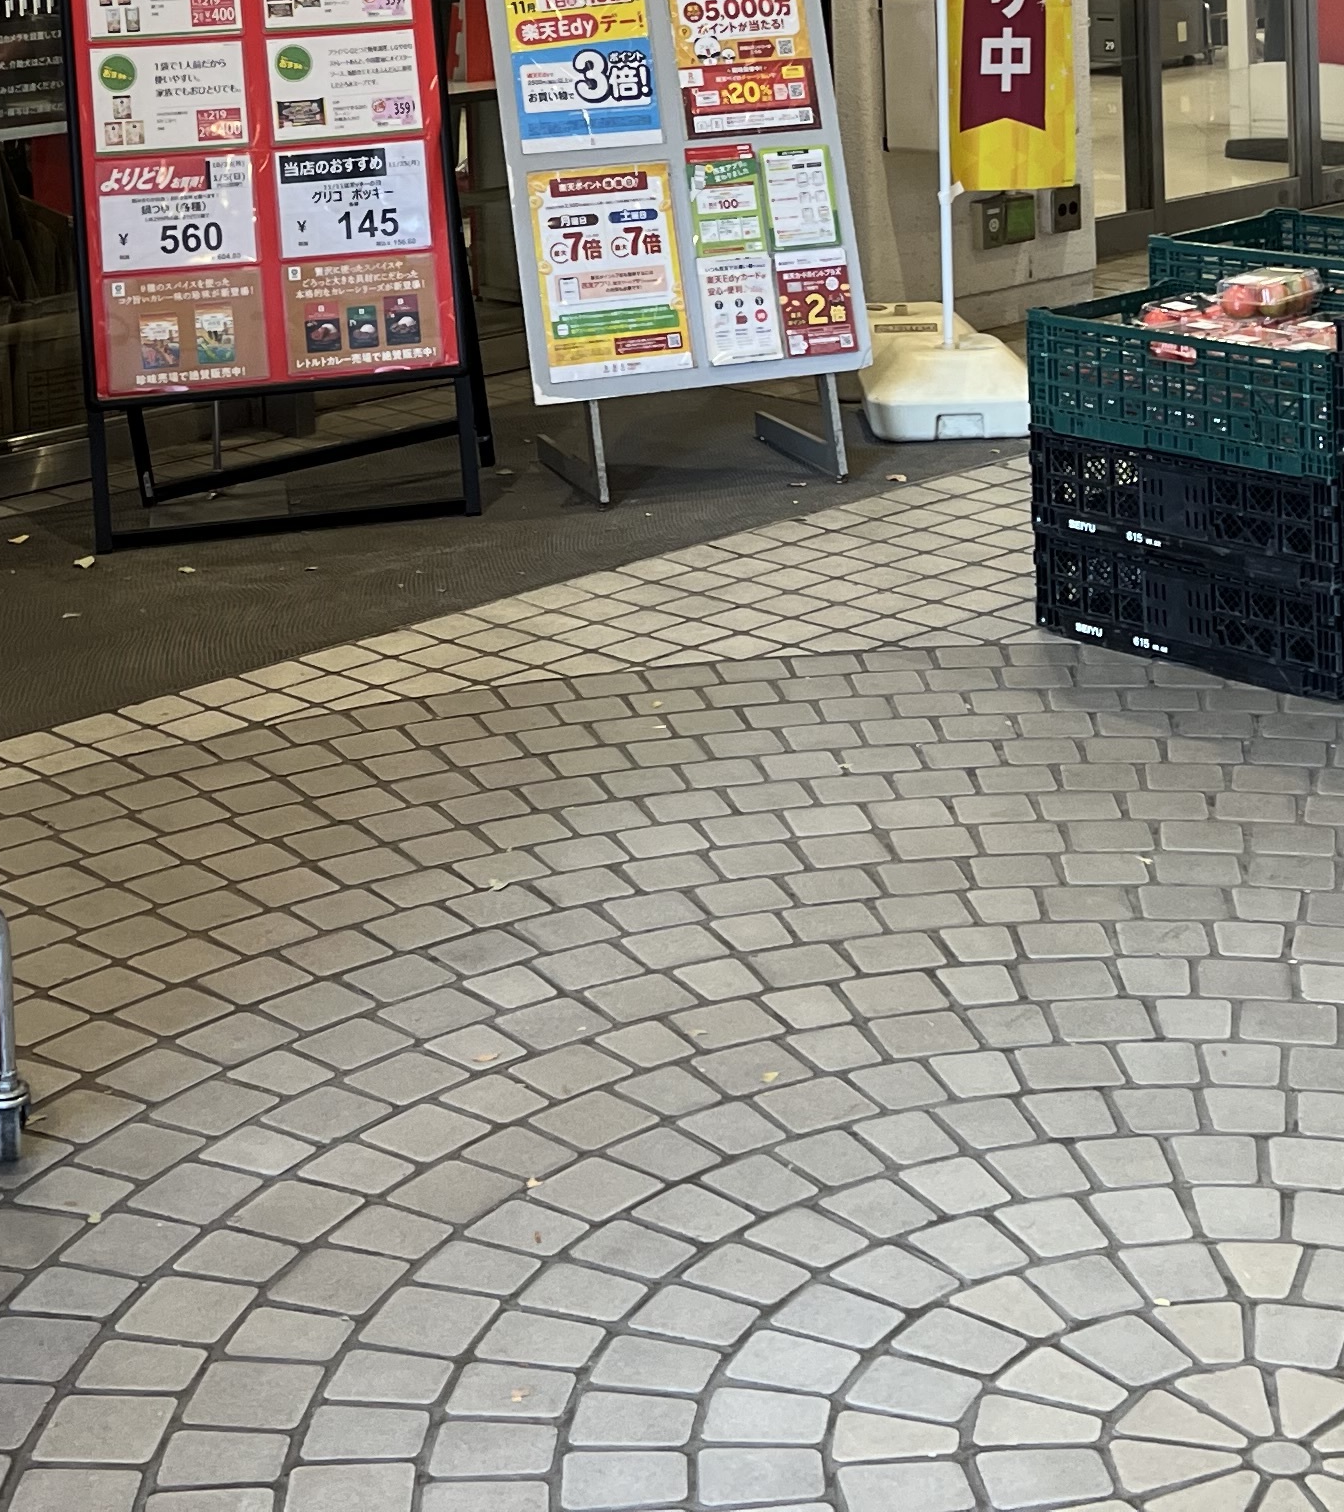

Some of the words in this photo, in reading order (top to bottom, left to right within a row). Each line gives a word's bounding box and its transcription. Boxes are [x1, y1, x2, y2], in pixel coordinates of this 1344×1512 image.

[609, 51, 645, 63] ポイント
[284, 155, 383, 177] 当店のおすすめ
[312, 191, 343, 204] グリコ
[352, 187, 394, 201] ポッキー
[338, 208, 399, 239] 145
[160, 222, 223, 254] 560
[1068, 519, 1096, 533] SEIYU
[1075, 622, 1103, 637] SEIYU
